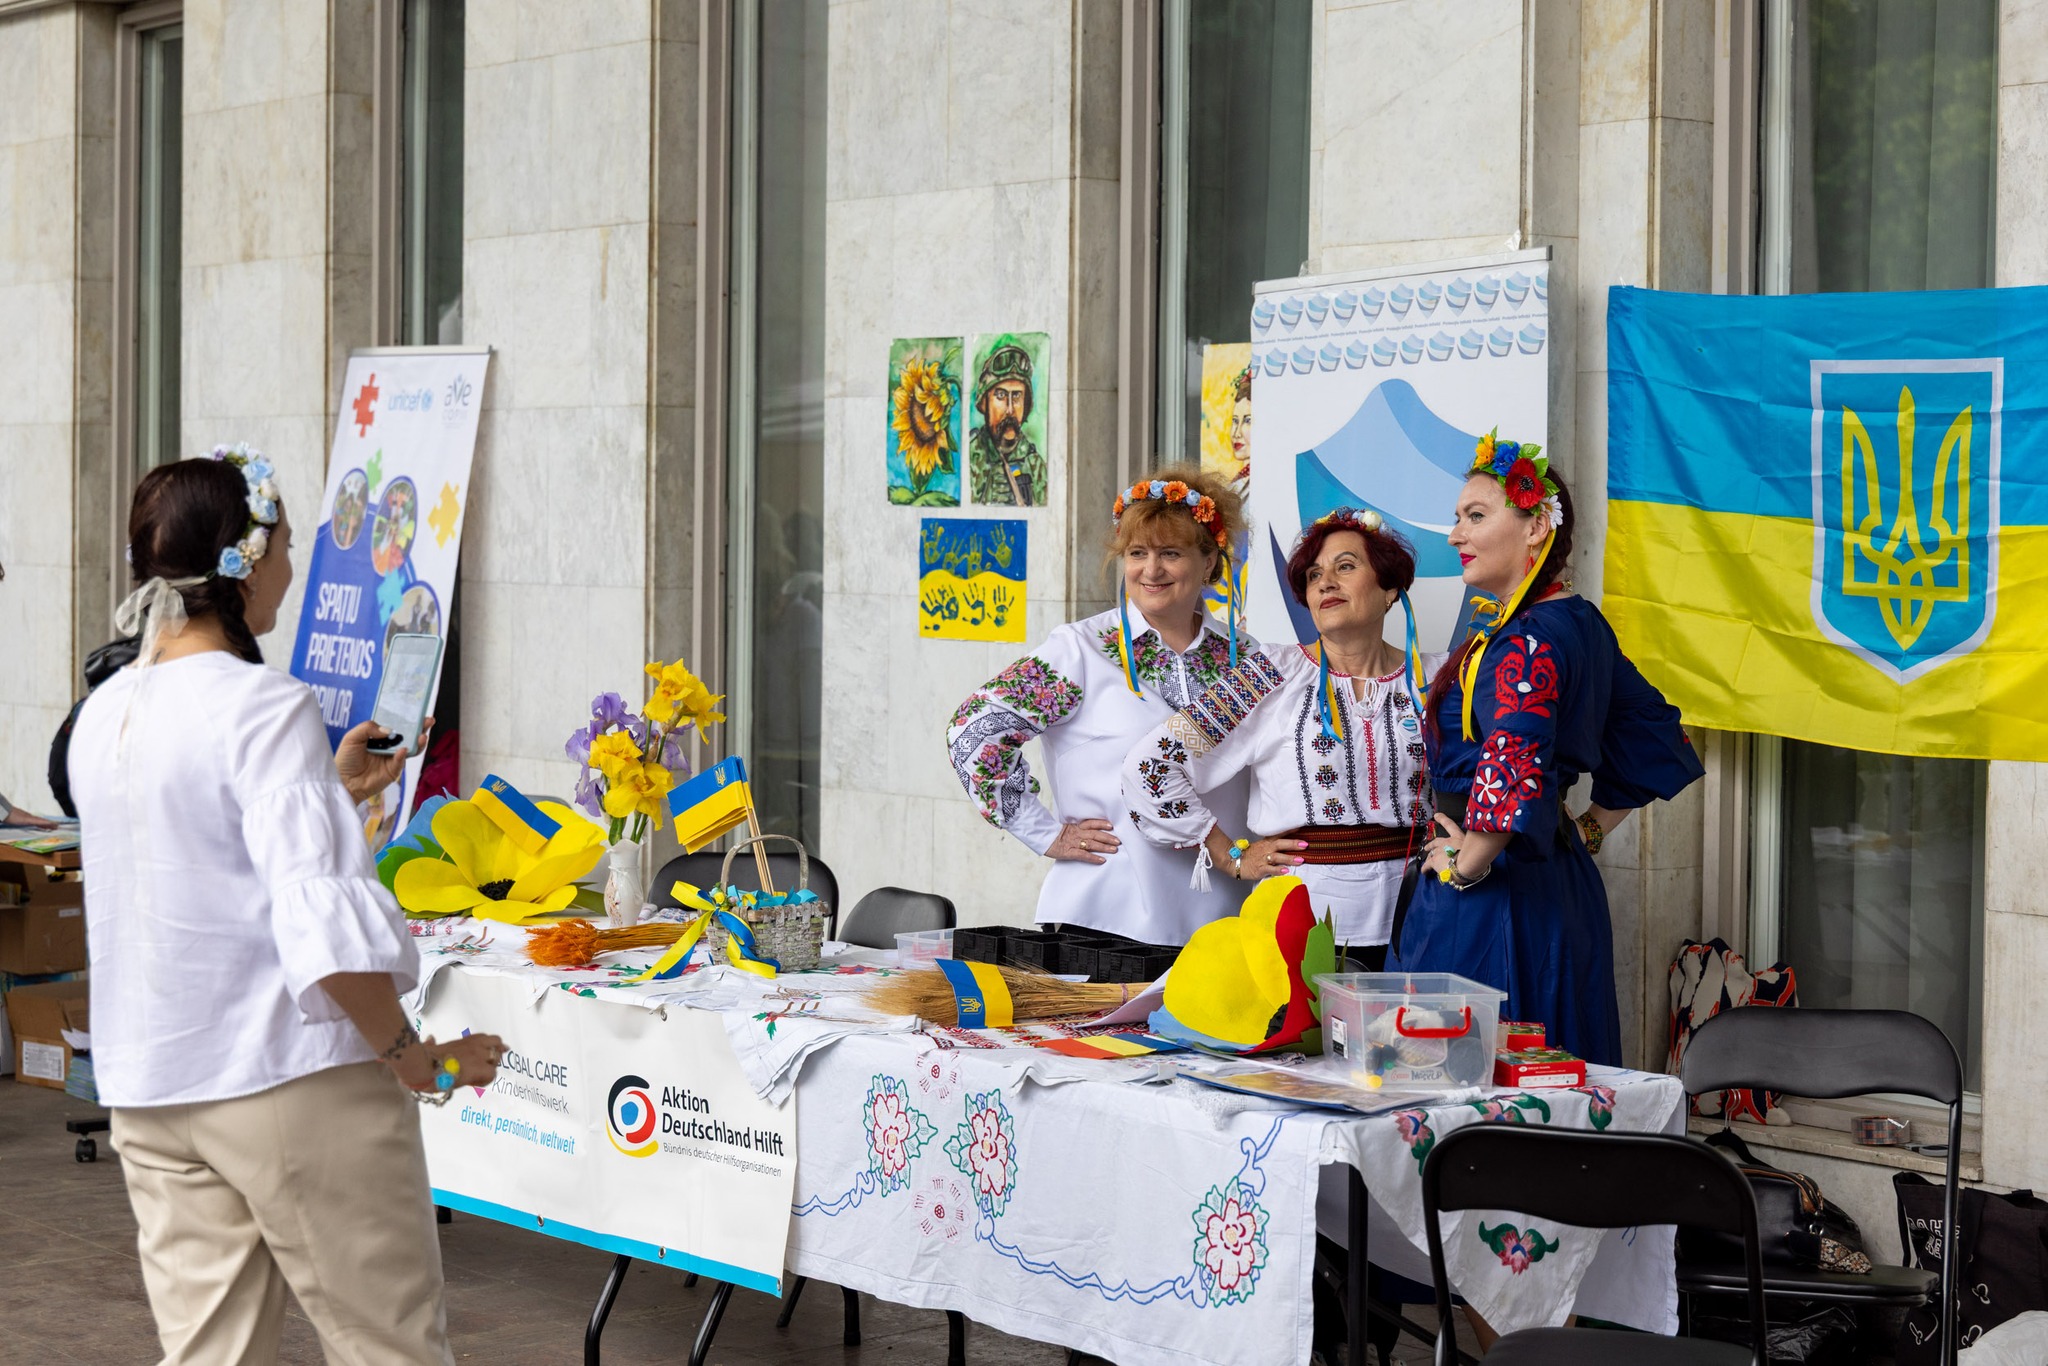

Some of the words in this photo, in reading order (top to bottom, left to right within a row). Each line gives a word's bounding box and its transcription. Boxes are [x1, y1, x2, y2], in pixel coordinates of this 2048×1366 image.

[388, 388, 422, 411] unicef
[315, 582, 362, 633] SPAȚIU
[305, 632, 375, 679] PRIETENOS
[304, 683, 353, 729] PIILOR
[496, 1051, 534, 1079] LOBAL
[535, 1060, 568, 1088] CARE
[492, 1076, 569, 1115] Kinderhilfswerk
[661, 1086, 710, 1114] Aktion
[461, 1105, 493, 1131] direkt,
[494, 1117, 538, 1145] persönlich,
[540, 1130, 576, 1154] weltweit
[662, 1112, 751, 1149] Deutschland
[754, 1129, 784, 1157] Hilft
[663, 1142, 692, 1157] Bündnis
[693, 1147, 723, 1163] deutscher
[723, 1153, 782, 1177] Hilfsorganisationen
